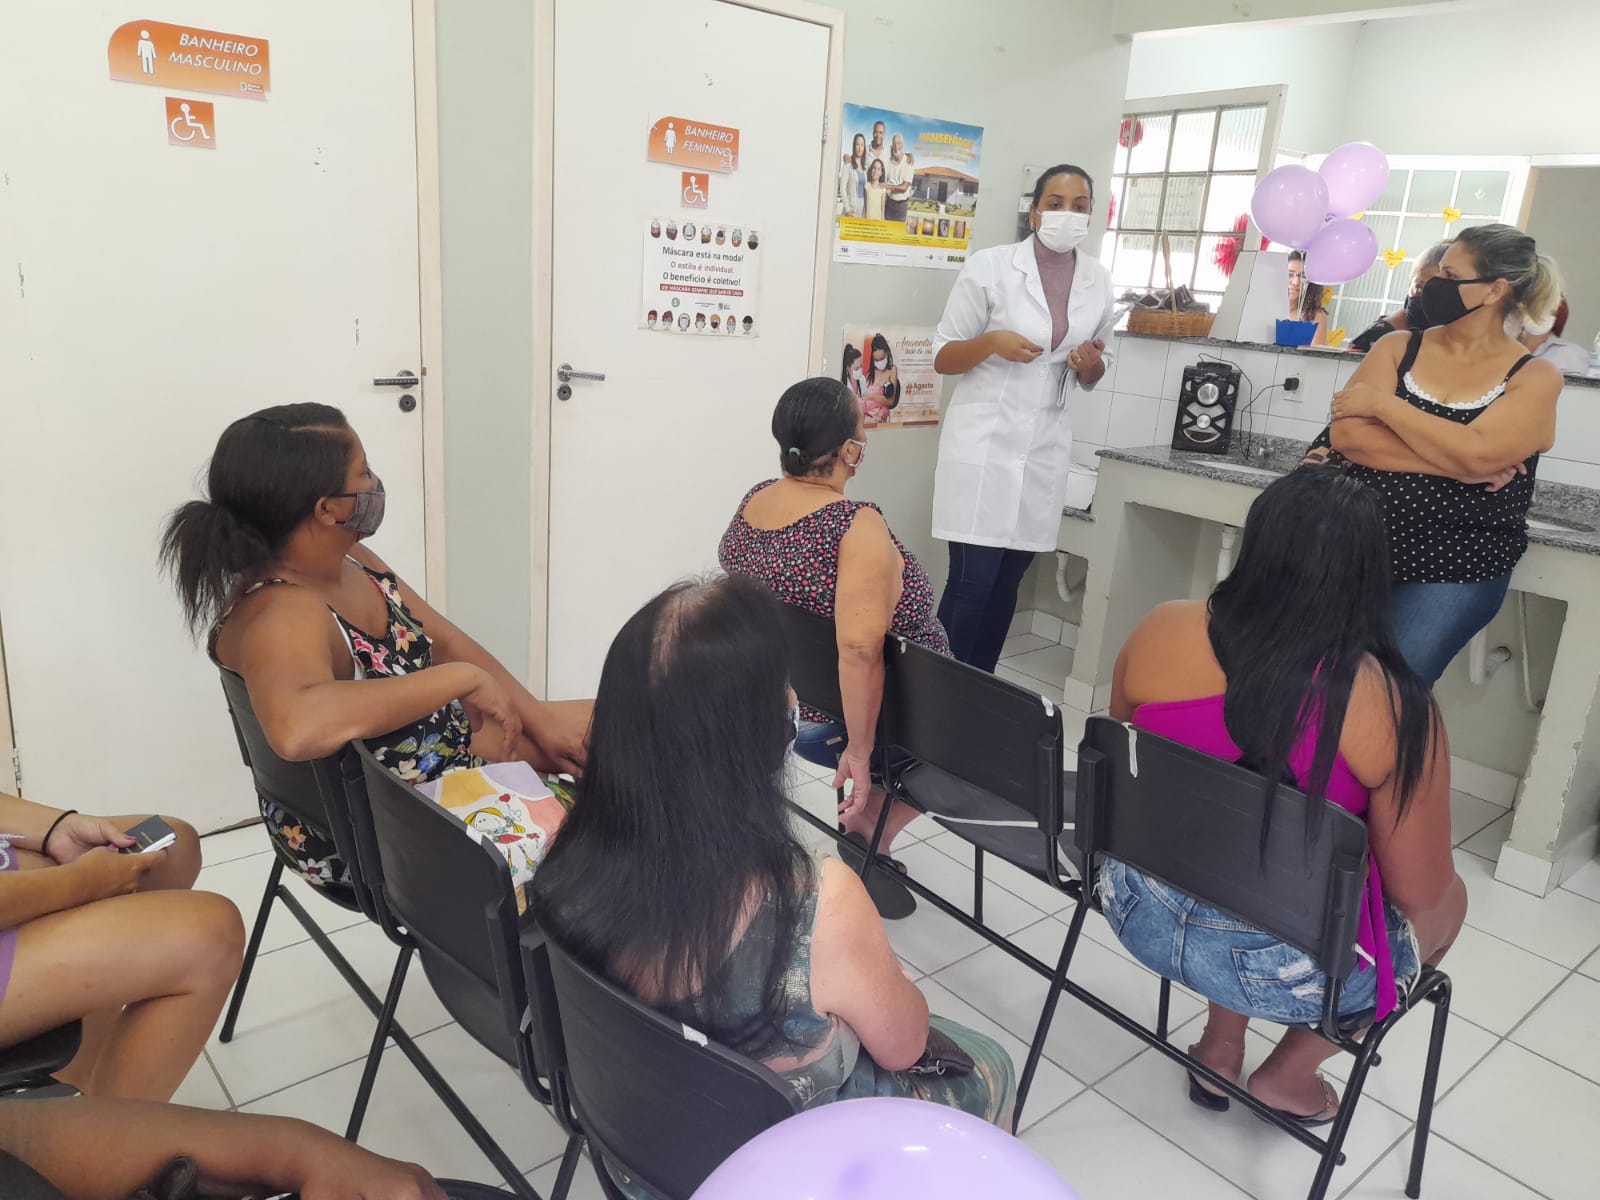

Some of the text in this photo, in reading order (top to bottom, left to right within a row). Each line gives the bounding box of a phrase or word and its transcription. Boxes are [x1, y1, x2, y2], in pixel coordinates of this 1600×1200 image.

[180, 34, 258, 57] BANHEIRO
[168, 51, 262, 75] MASCULINO
[684, 125, 734, 143] BANHEIRO
[683, 140, 731, 157] FEMININO
[662, 246, 694, 257] Máscara
[695, 250, 711, 260] está
[722, 254, 744, 262] moda!
[677, 262, 697, 271] estilo
[662, 272, 669, 280] O
[707, 276, 712, 284] é
[713, 277, 741, 286] coletivo!
